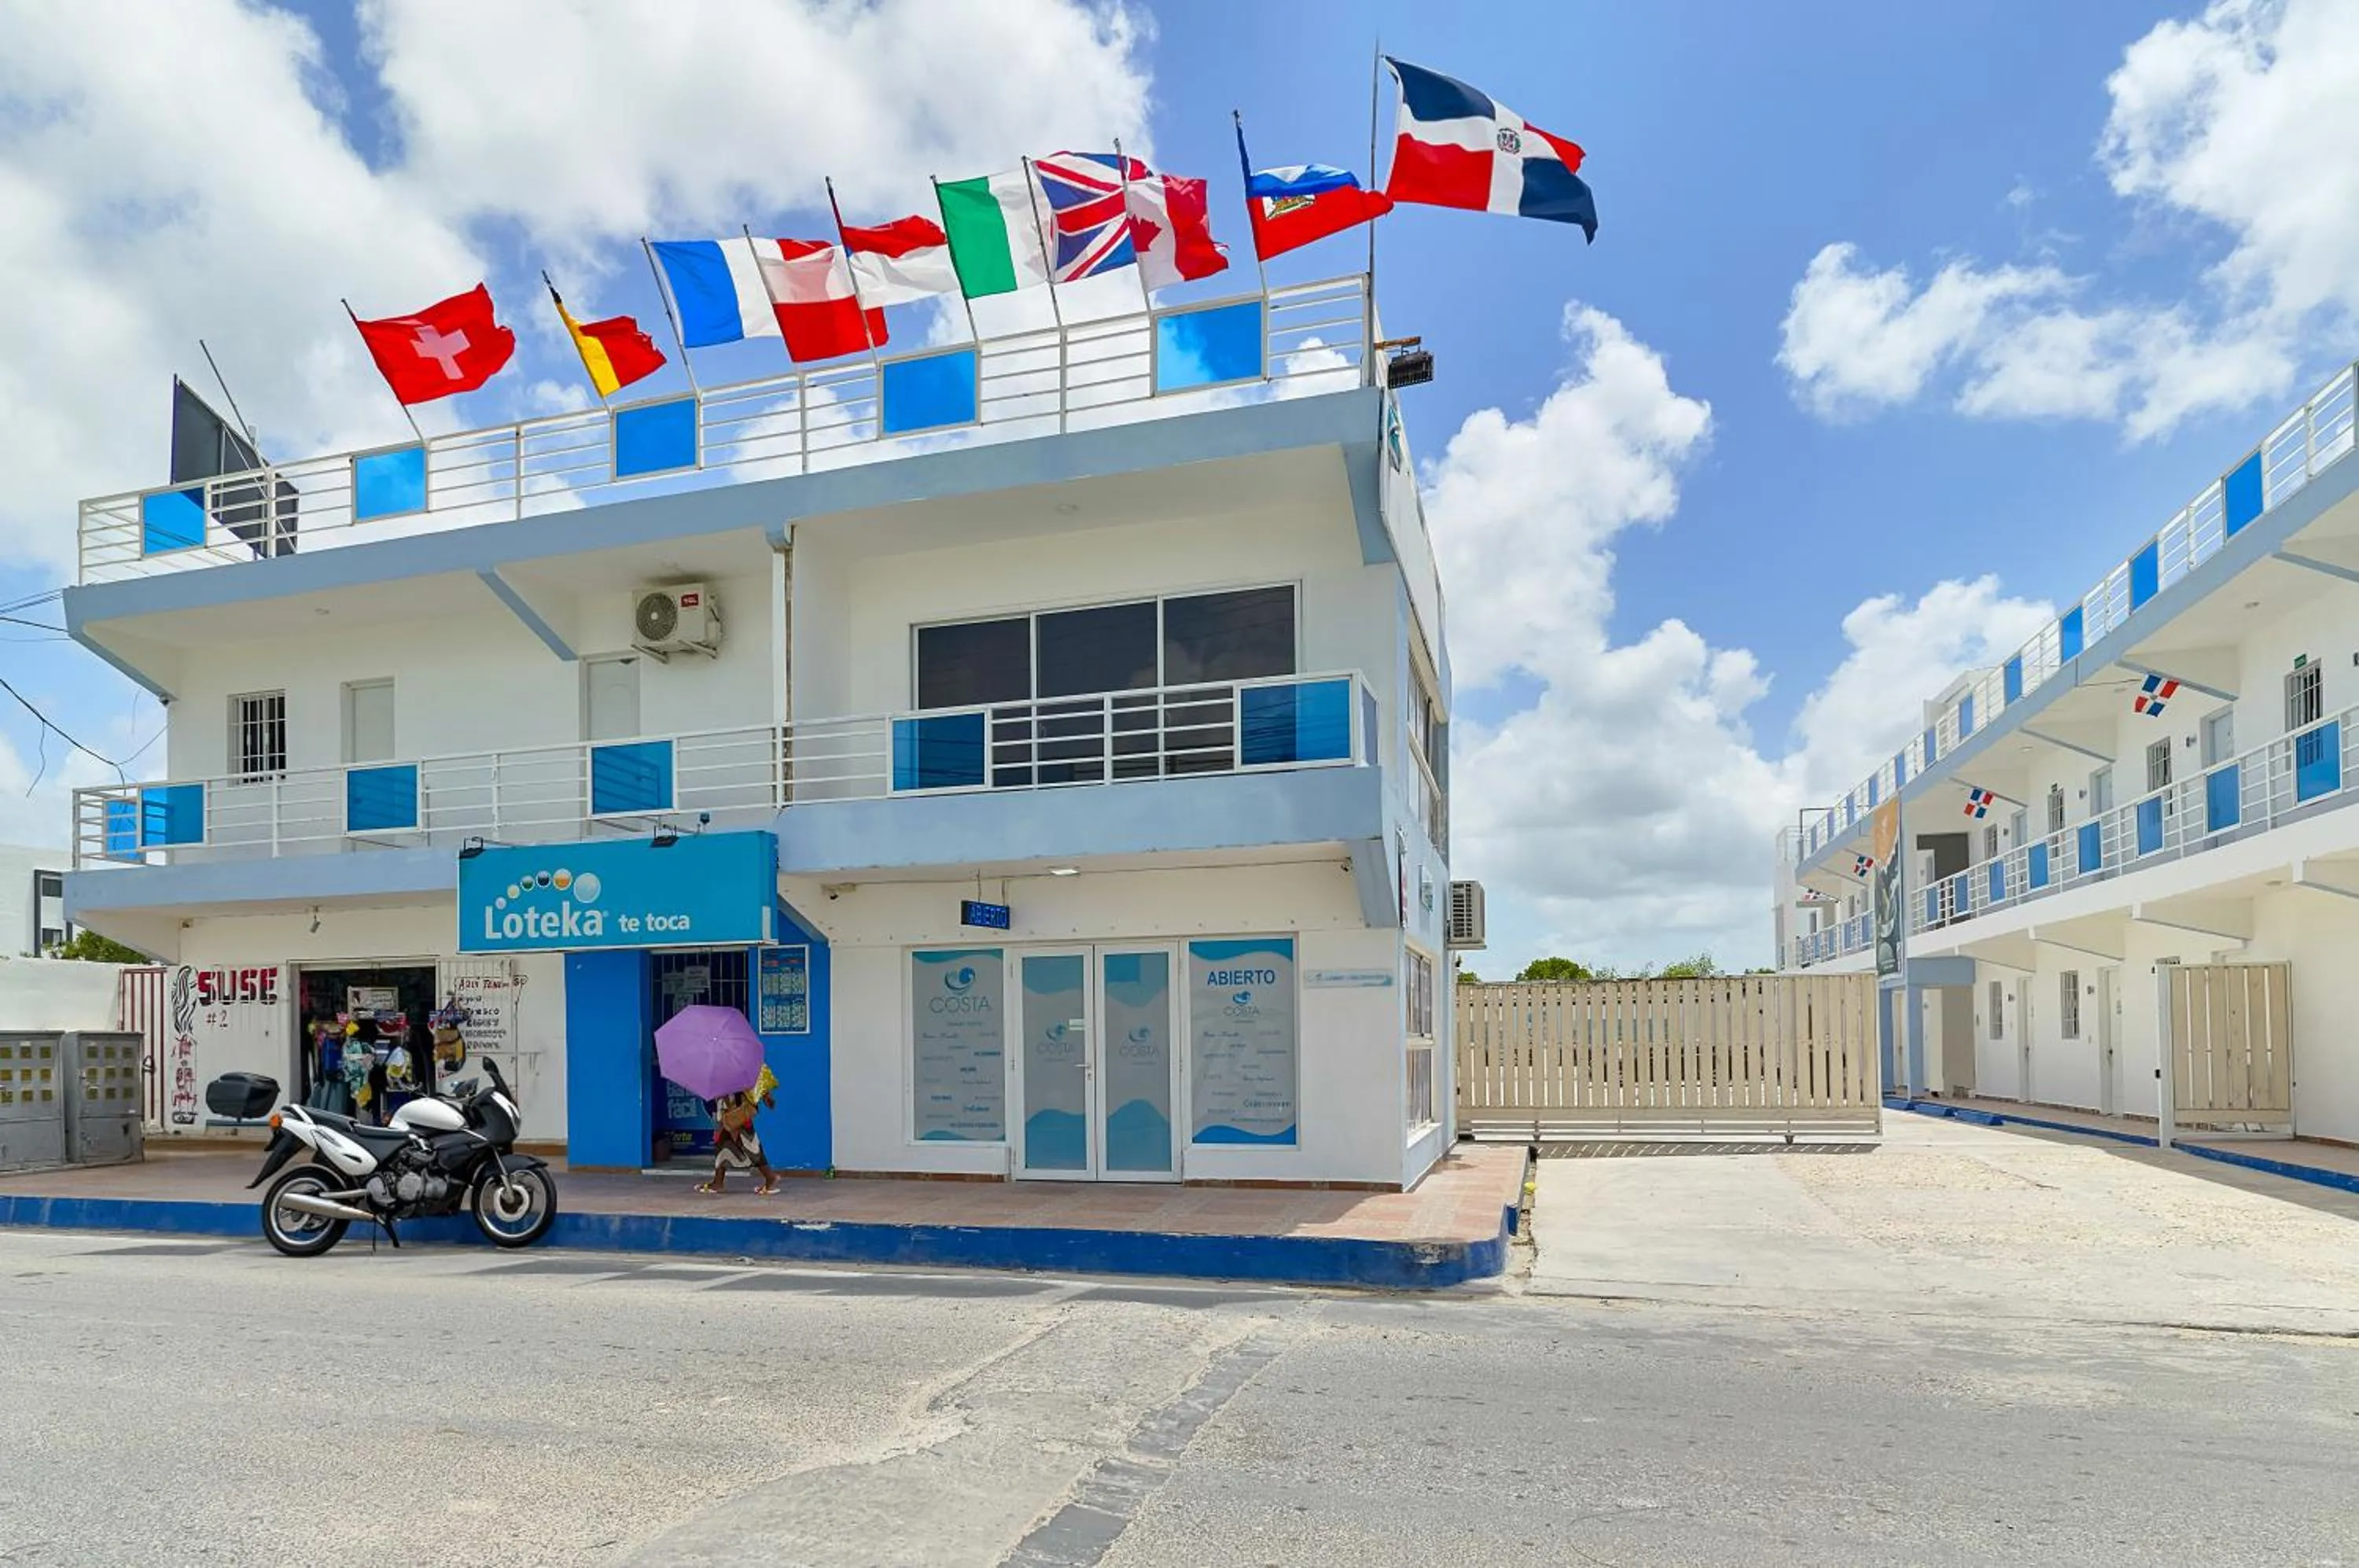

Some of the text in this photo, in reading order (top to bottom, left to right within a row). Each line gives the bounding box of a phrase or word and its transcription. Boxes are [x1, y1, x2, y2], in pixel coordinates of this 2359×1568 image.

[485, 900, 690, 940] Loteka te toca
[969, 904, 1007, 927] ABIERTO
[197, 967, 278, 1007] SUSE
[1207, 970, 1275, 985] ABIERTO
[929, 996, 992, 1014] COSTA
[1223, 1006, 1260, 1016] COSTA
